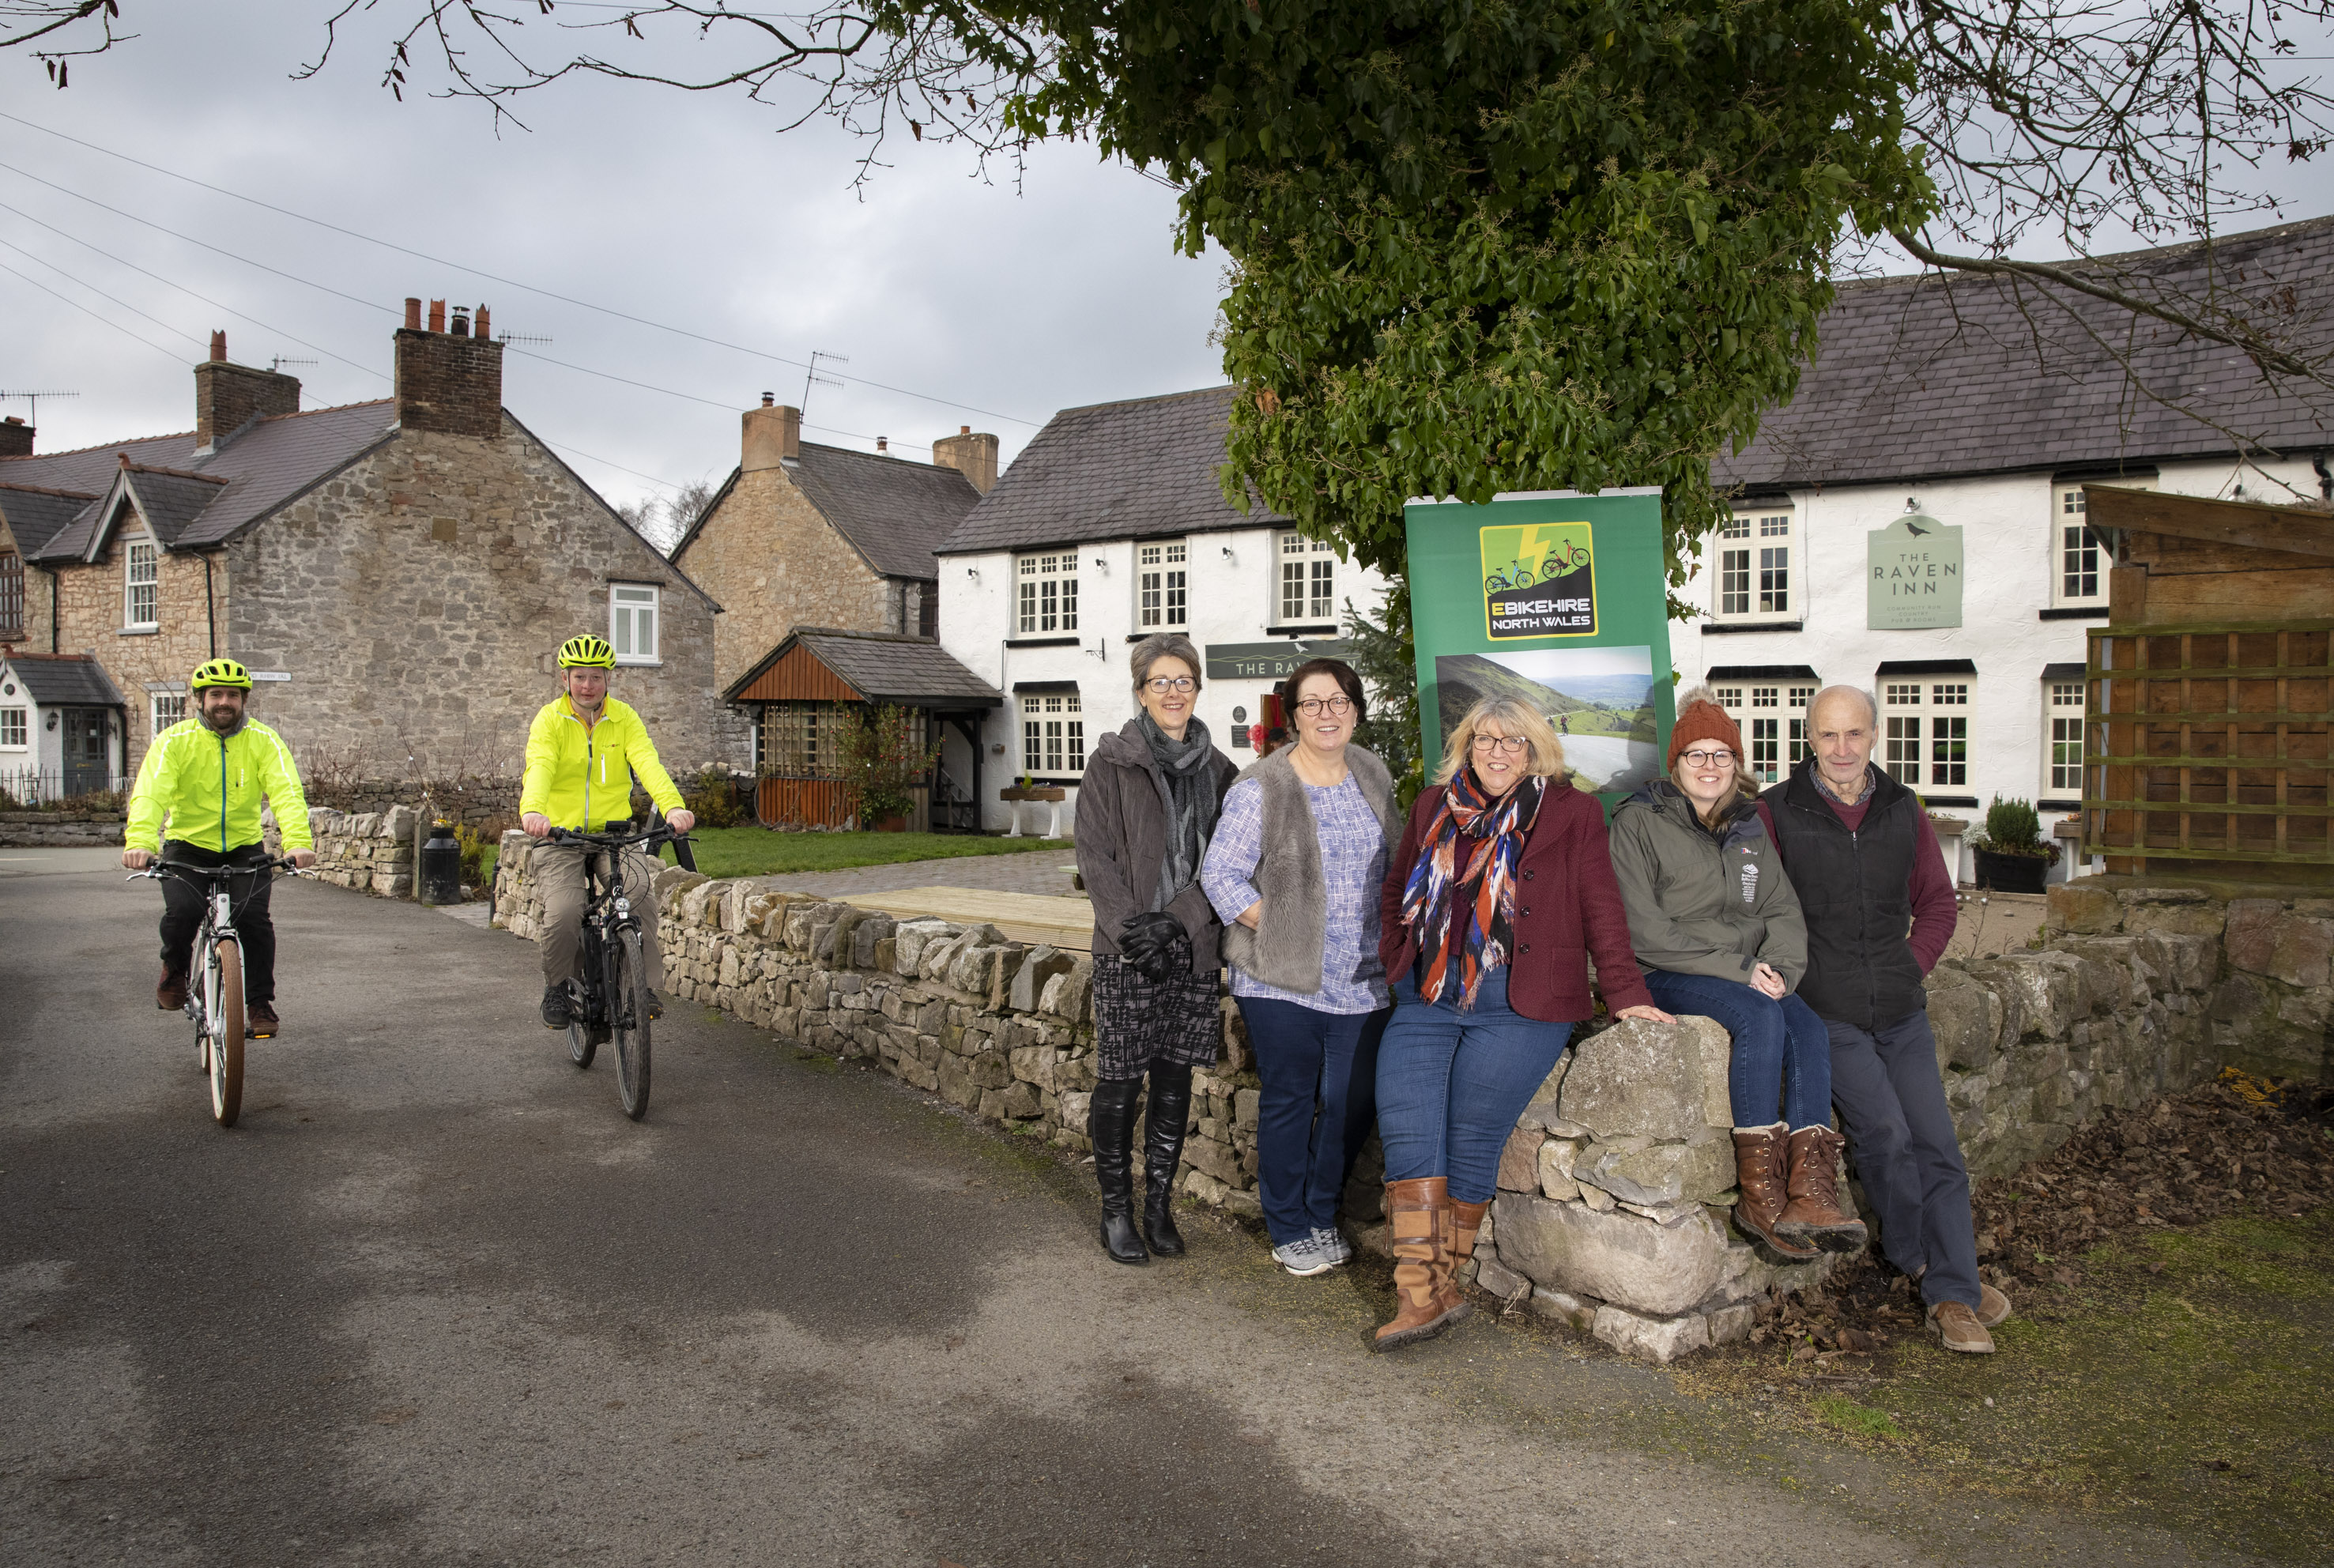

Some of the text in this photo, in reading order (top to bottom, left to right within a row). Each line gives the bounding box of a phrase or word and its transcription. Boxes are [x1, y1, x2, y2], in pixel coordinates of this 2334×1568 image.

[1899, 552, 1929, 562] THE
[1874, 563, 1957, 579] RAVEN
[1893, 581, 1936, 595] INN
[1491, 598, 1590, 616] EBIKEHIRE
[1492, 616, 1590, 630] NORTH WALES
[1235, 663, 1265, 675] THE
[1276, 660, 1356, 674] RAN
